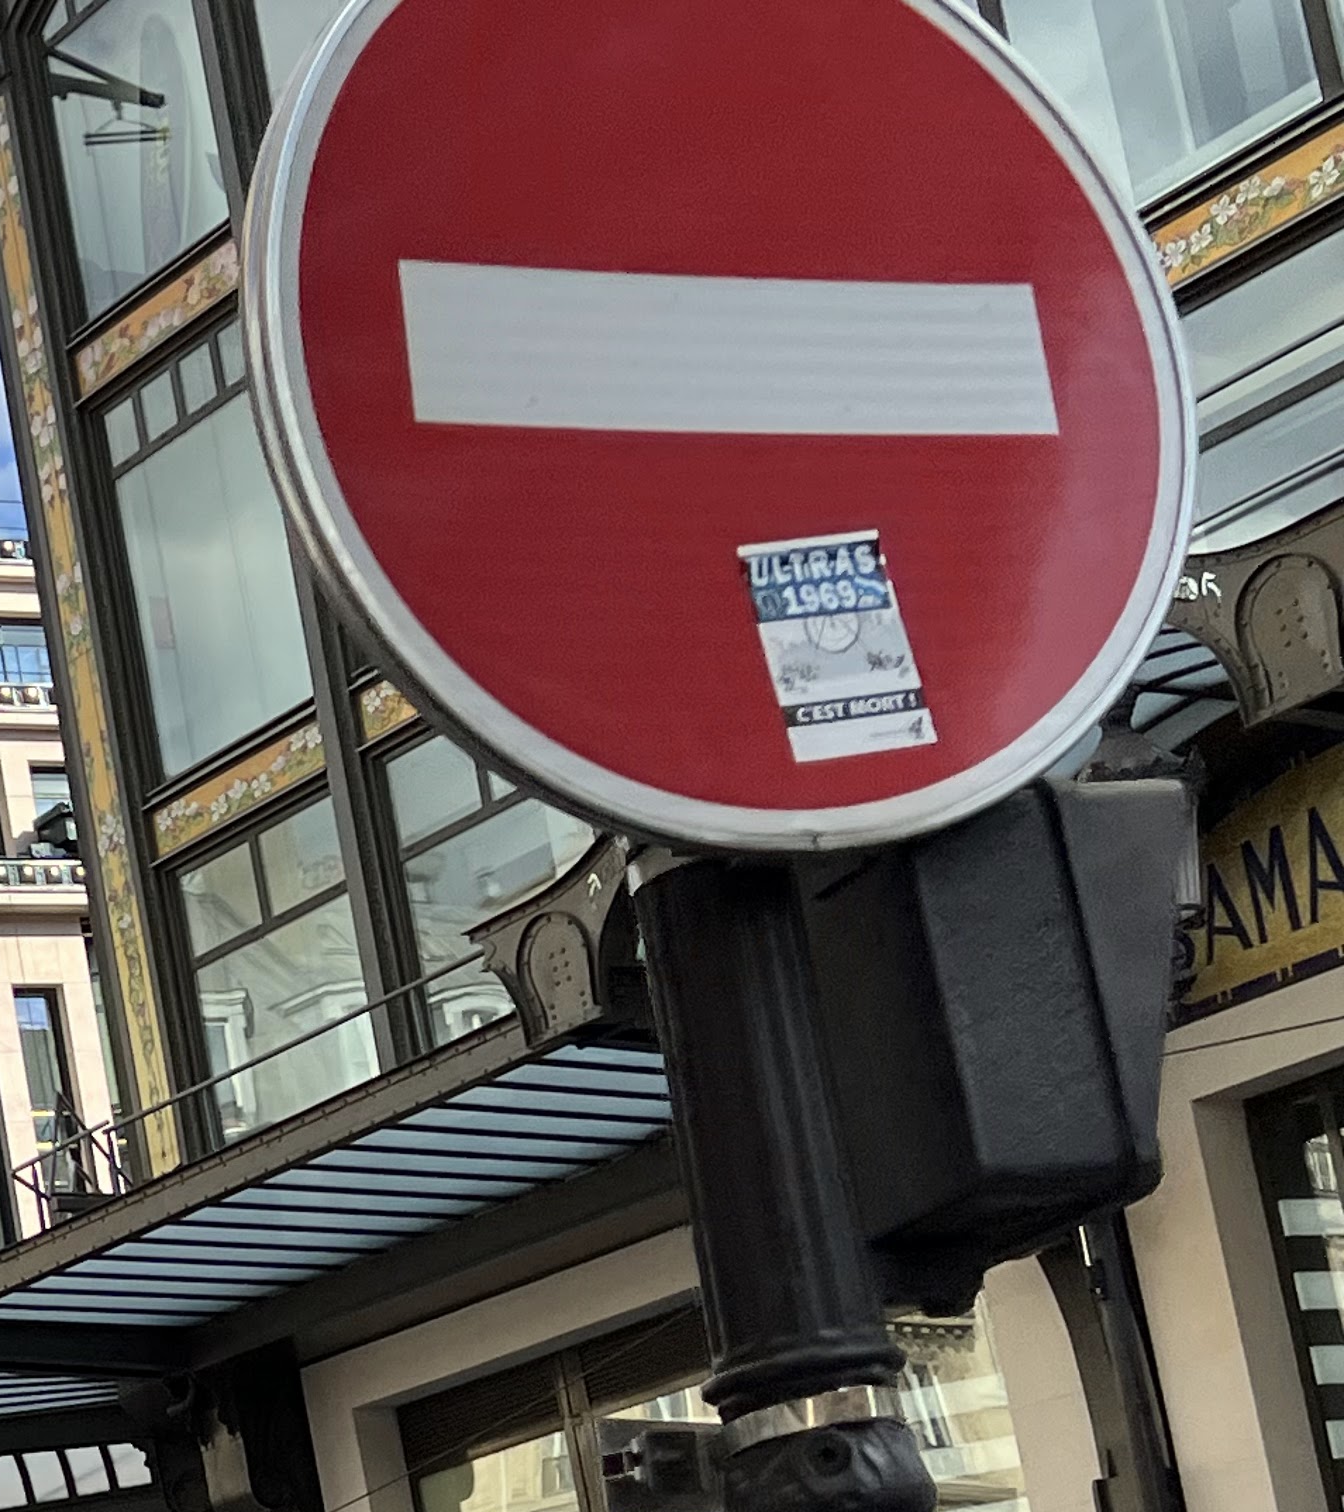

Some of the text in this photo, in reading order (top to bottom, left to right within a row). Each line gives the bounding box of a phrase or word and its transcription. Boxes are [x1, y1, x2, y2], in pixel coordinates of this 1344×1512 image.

[749, 544, 877, 587] ULTRAS
[781, 579, 858, 616] 1969
[849, 693, 905, 716] MORT
